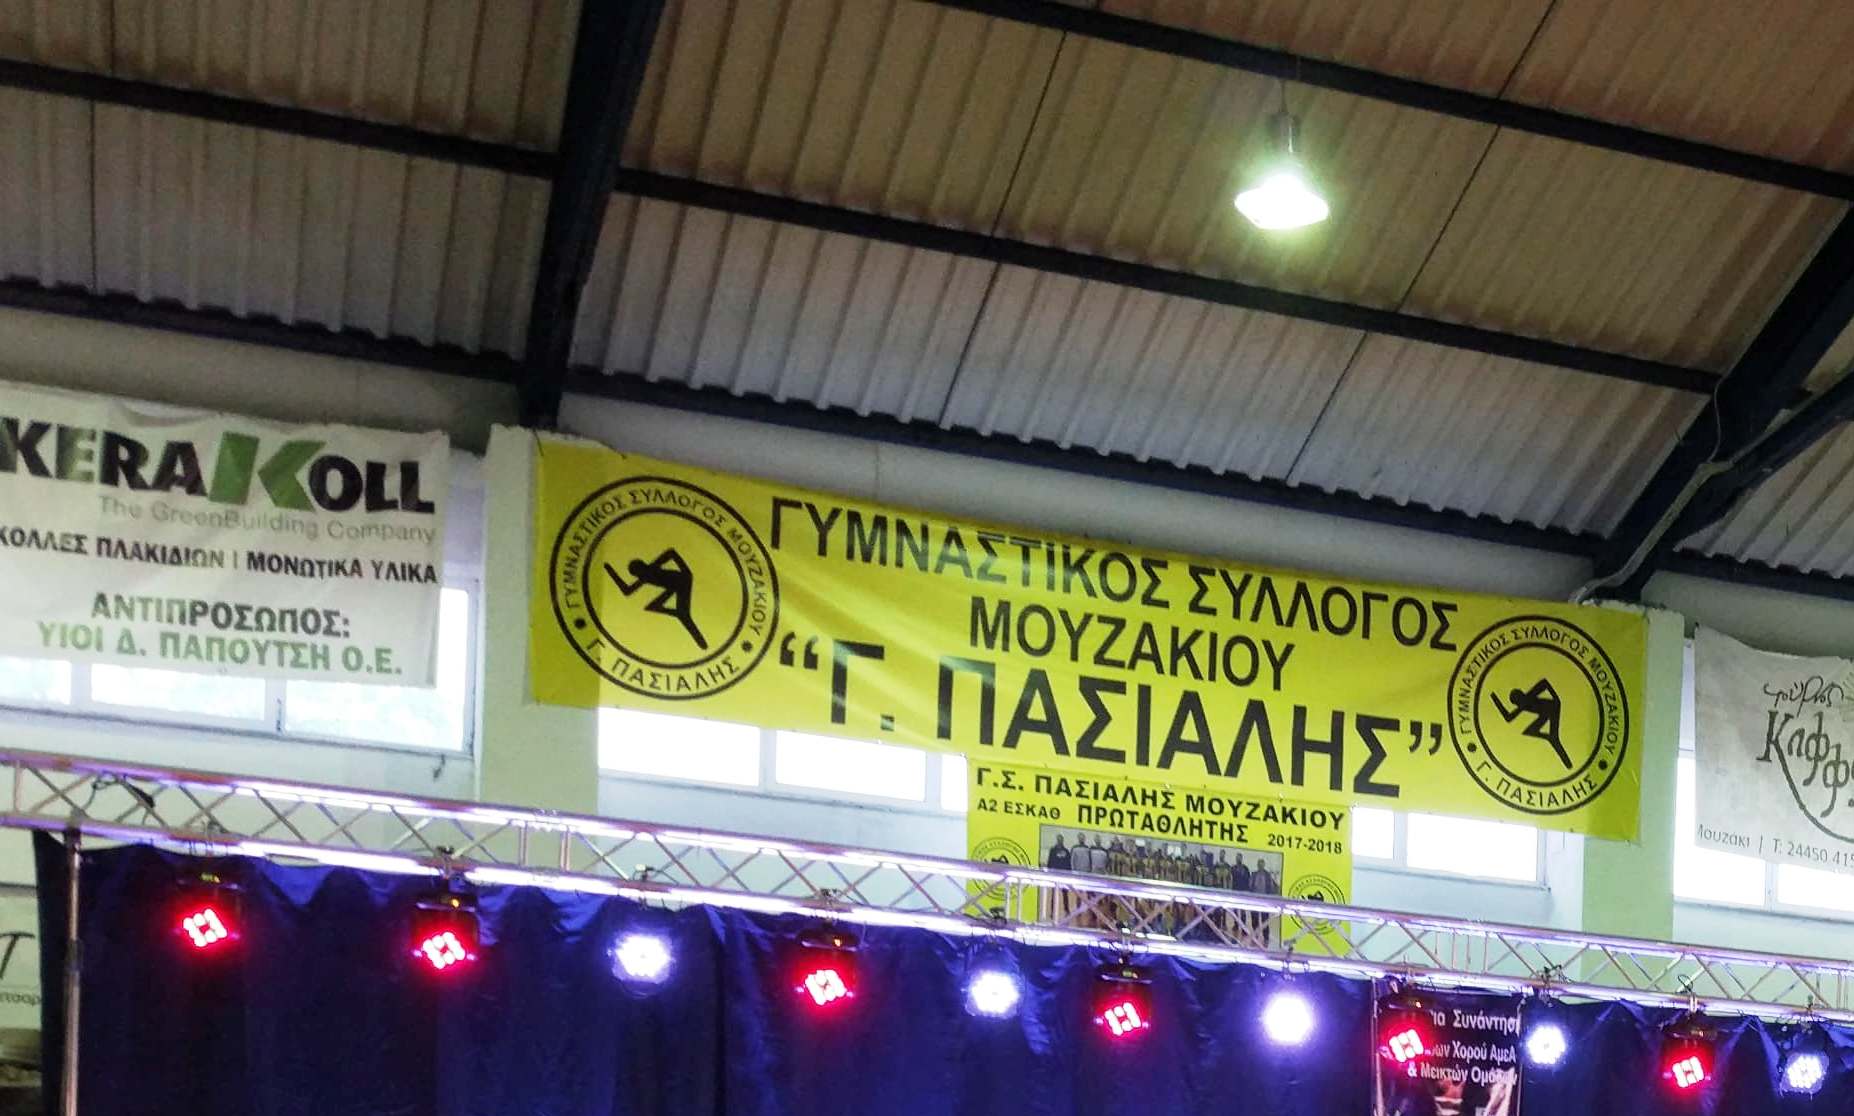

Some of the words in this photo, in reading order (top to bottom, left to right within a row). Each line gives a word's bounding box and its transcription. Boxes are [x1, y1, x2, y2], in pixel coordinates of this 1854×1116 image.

[99, 496, 143, 521] The
[153, 499, 318, 540] GreenBuilding
[327, 519, 437, 545] Company
[96, 536, 225, 569] ΠΛΑΚΙΔΙΩΝ
[247, 550, 363, 579] ΜΟΝΩΤΙΚΑ
[371, 558, 438, 584] ΥΛΙΚΑ
[562, 495, 627, 610] ΓΥΜΝΑΣΤΙΚΟΣ
[629, 488, 726, 528] ΣΥΛΛΟΓΟΣ
[728, 527, 768, 637] ΜΟΥΖΑΚΙΟΥ
[770, 495, 1170, 609] ΓΥΜΝΑΣΤΙΚΟΣ
[1187, 566, 1459, 653] ΣΥΛΛΟΓΟΣ
[91, 592, 350, 639] ΑΝΤΙΠΡΟΣΩΠΟΣ:
[37, 620, 103, 651] ΥΙΟΙ
[116, 627, 146, 656] Δ.
[160, 631, 330, 672] ΠΑΠΟΥΤΣΗ
[343, 646, 402, 675] Ο.Ε.
[969, 595, 1295, 692] ΜΟΥΖΑΚΙΟΥ
[612, 657, 740, 693] ΠΑΣΙΑΛΗΣ
[1458, 633, 1509, 735] ΓΥΜΝΑΣΤΙΚΟΣ
[1511, 625, 1589, 658] ΣΥΛΛΟΓΟΣ
[1588, 657, 1618, 755] ΜΟΥΖΑΚΙΟΥ
[976, 767, 1024, 791] Γ.Σ.
[1035, 774, 1176, 811] ΠΑΣΙΑΛΗΣ
[1185, 794, 1344, 831] ΜΟΥΖΑΚΙΟΥ
[977, 798, 997, 813] Α2
[1003, 801, 1061, 820] ΕΣΚΑΘ
[1496, 774, 1597, 808] ΠΑΣΙΑΛΗΣ
[1077, 804, 1249, 843] ΠΡΩΤΑΘΛΗΤΗΣ
[1267, 832, 1343, 855] 2017-2018
[1787, 841, 1828, 864] 24450
[1407, 1061, 1418, 1077] &
[1420, 1062, 1468, 1082] Μεικτών
[1452, 1040, 1487, 1064] Χορού
[1490, 1044, 1517, 1066] ΑμεΑ
